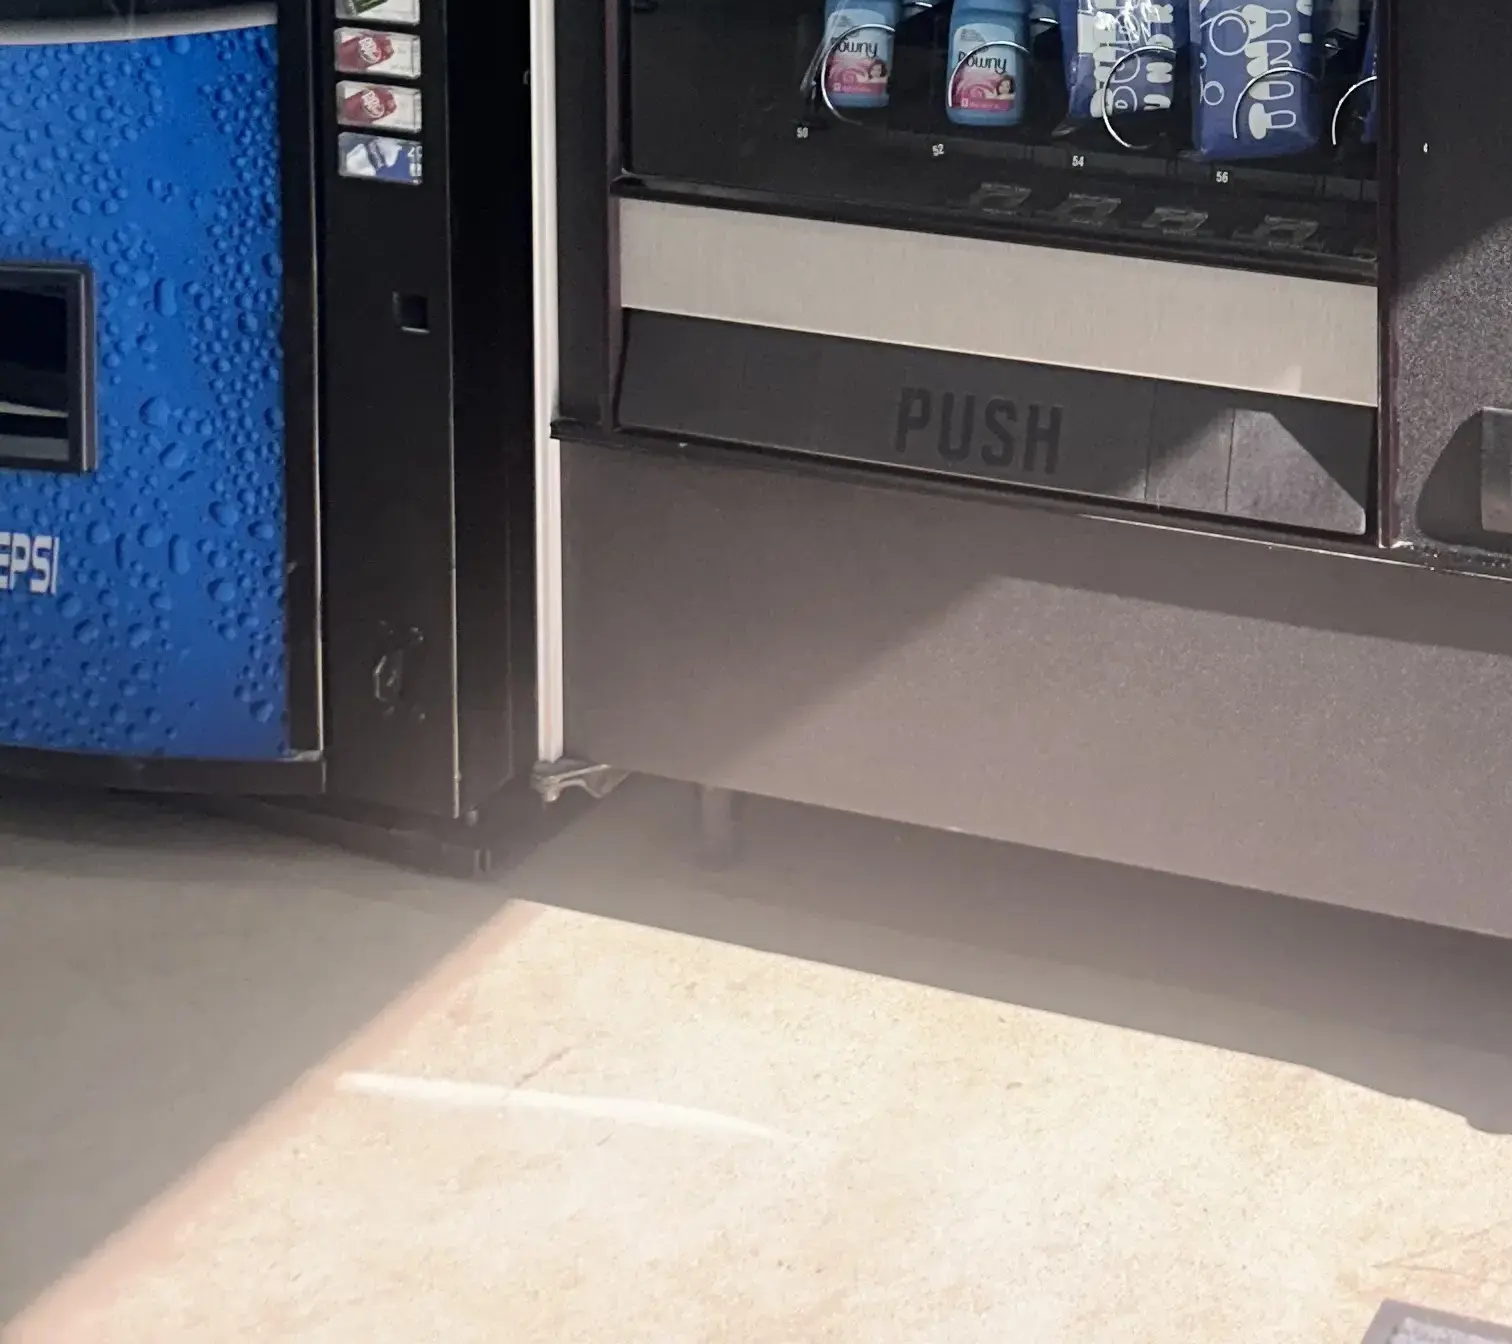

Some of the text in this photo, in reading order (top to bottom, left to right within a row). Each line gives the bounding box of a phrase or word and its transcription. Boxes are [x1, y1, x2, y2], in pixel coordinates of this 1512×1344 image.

[796, 127, 809, 138] 50
[932, 144, 944, 155] 52
[1072, 155, 1084, 167] 54
[1216, 172, 1229, 183] 56
[898, 386, 1063, 475] PUSH
